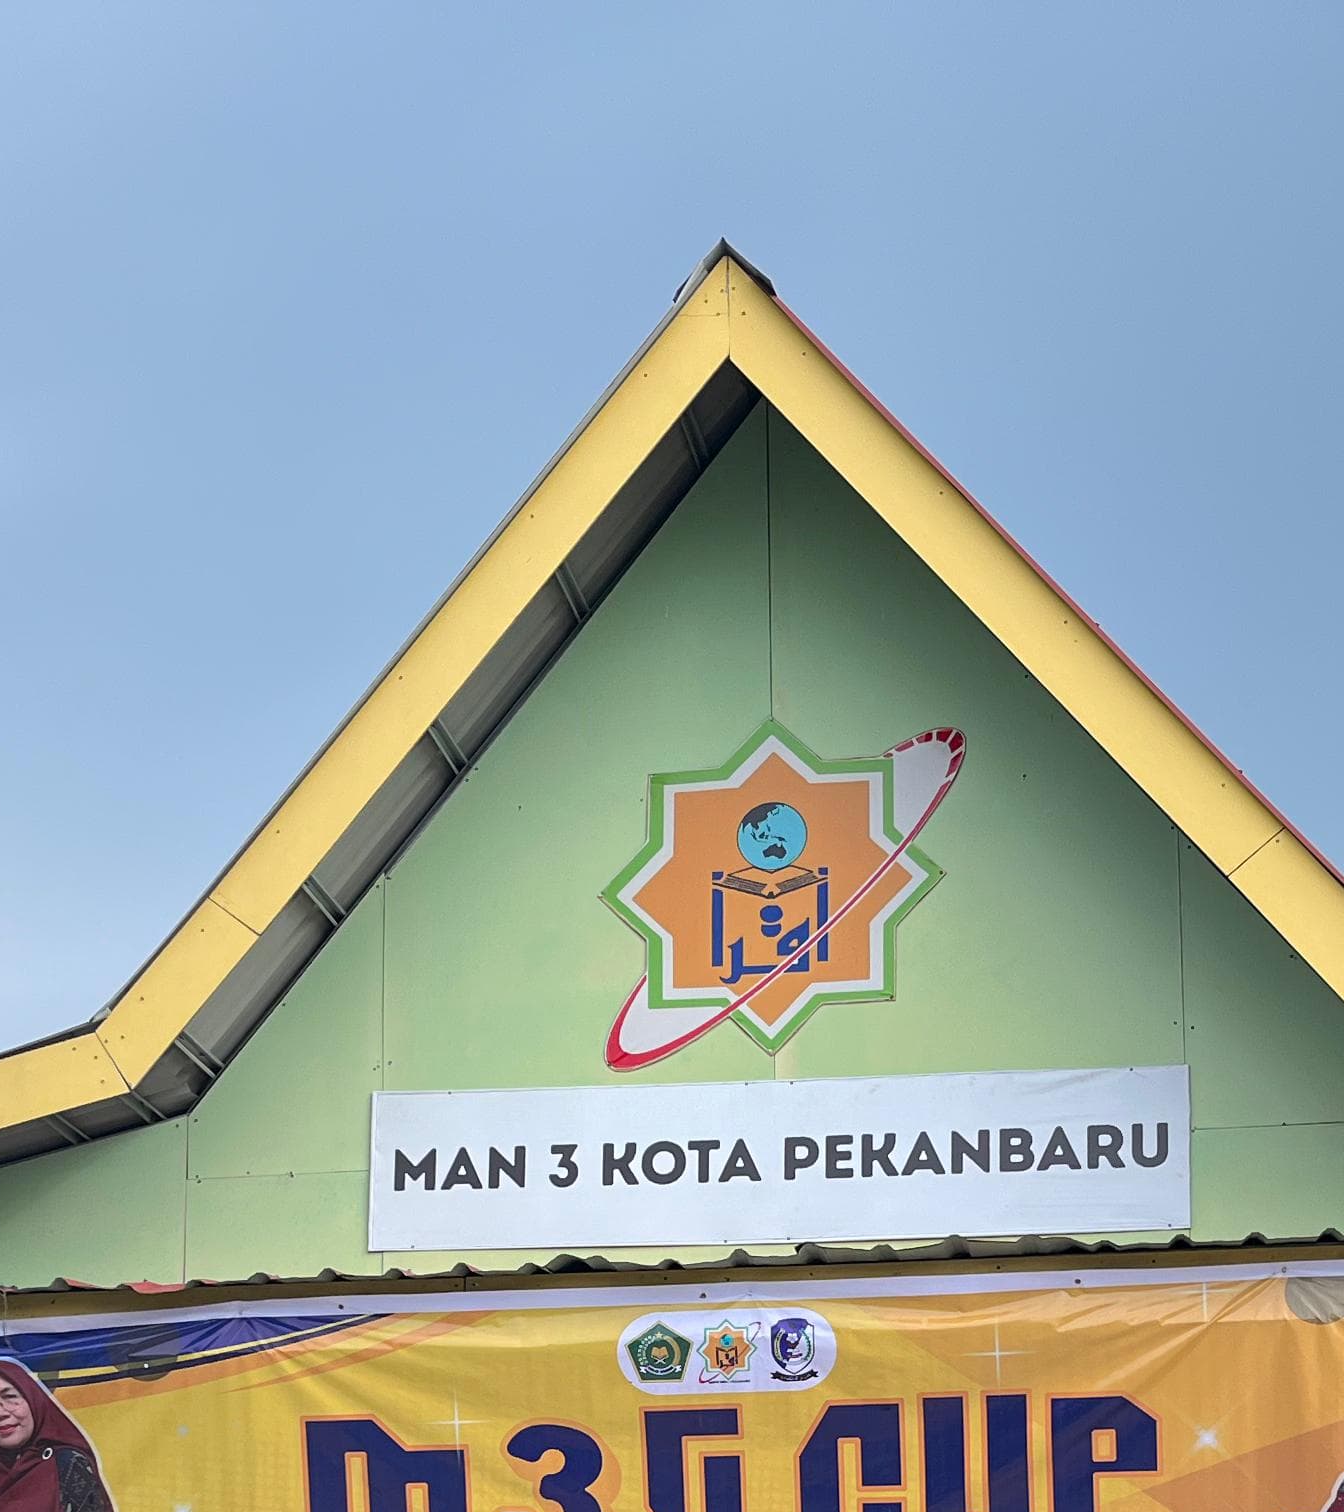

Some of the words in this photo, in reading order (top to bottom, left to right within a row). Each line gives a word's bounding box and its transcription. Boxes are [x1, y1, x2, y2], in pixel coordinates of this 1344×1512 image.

[393, 1146, 527, 1191] MAN
[548, 1144, 580, 1188] 3
[602, 1139, 761, 1186] KOTA
[783, 1122, 1170, 1180] PEKANBARU
